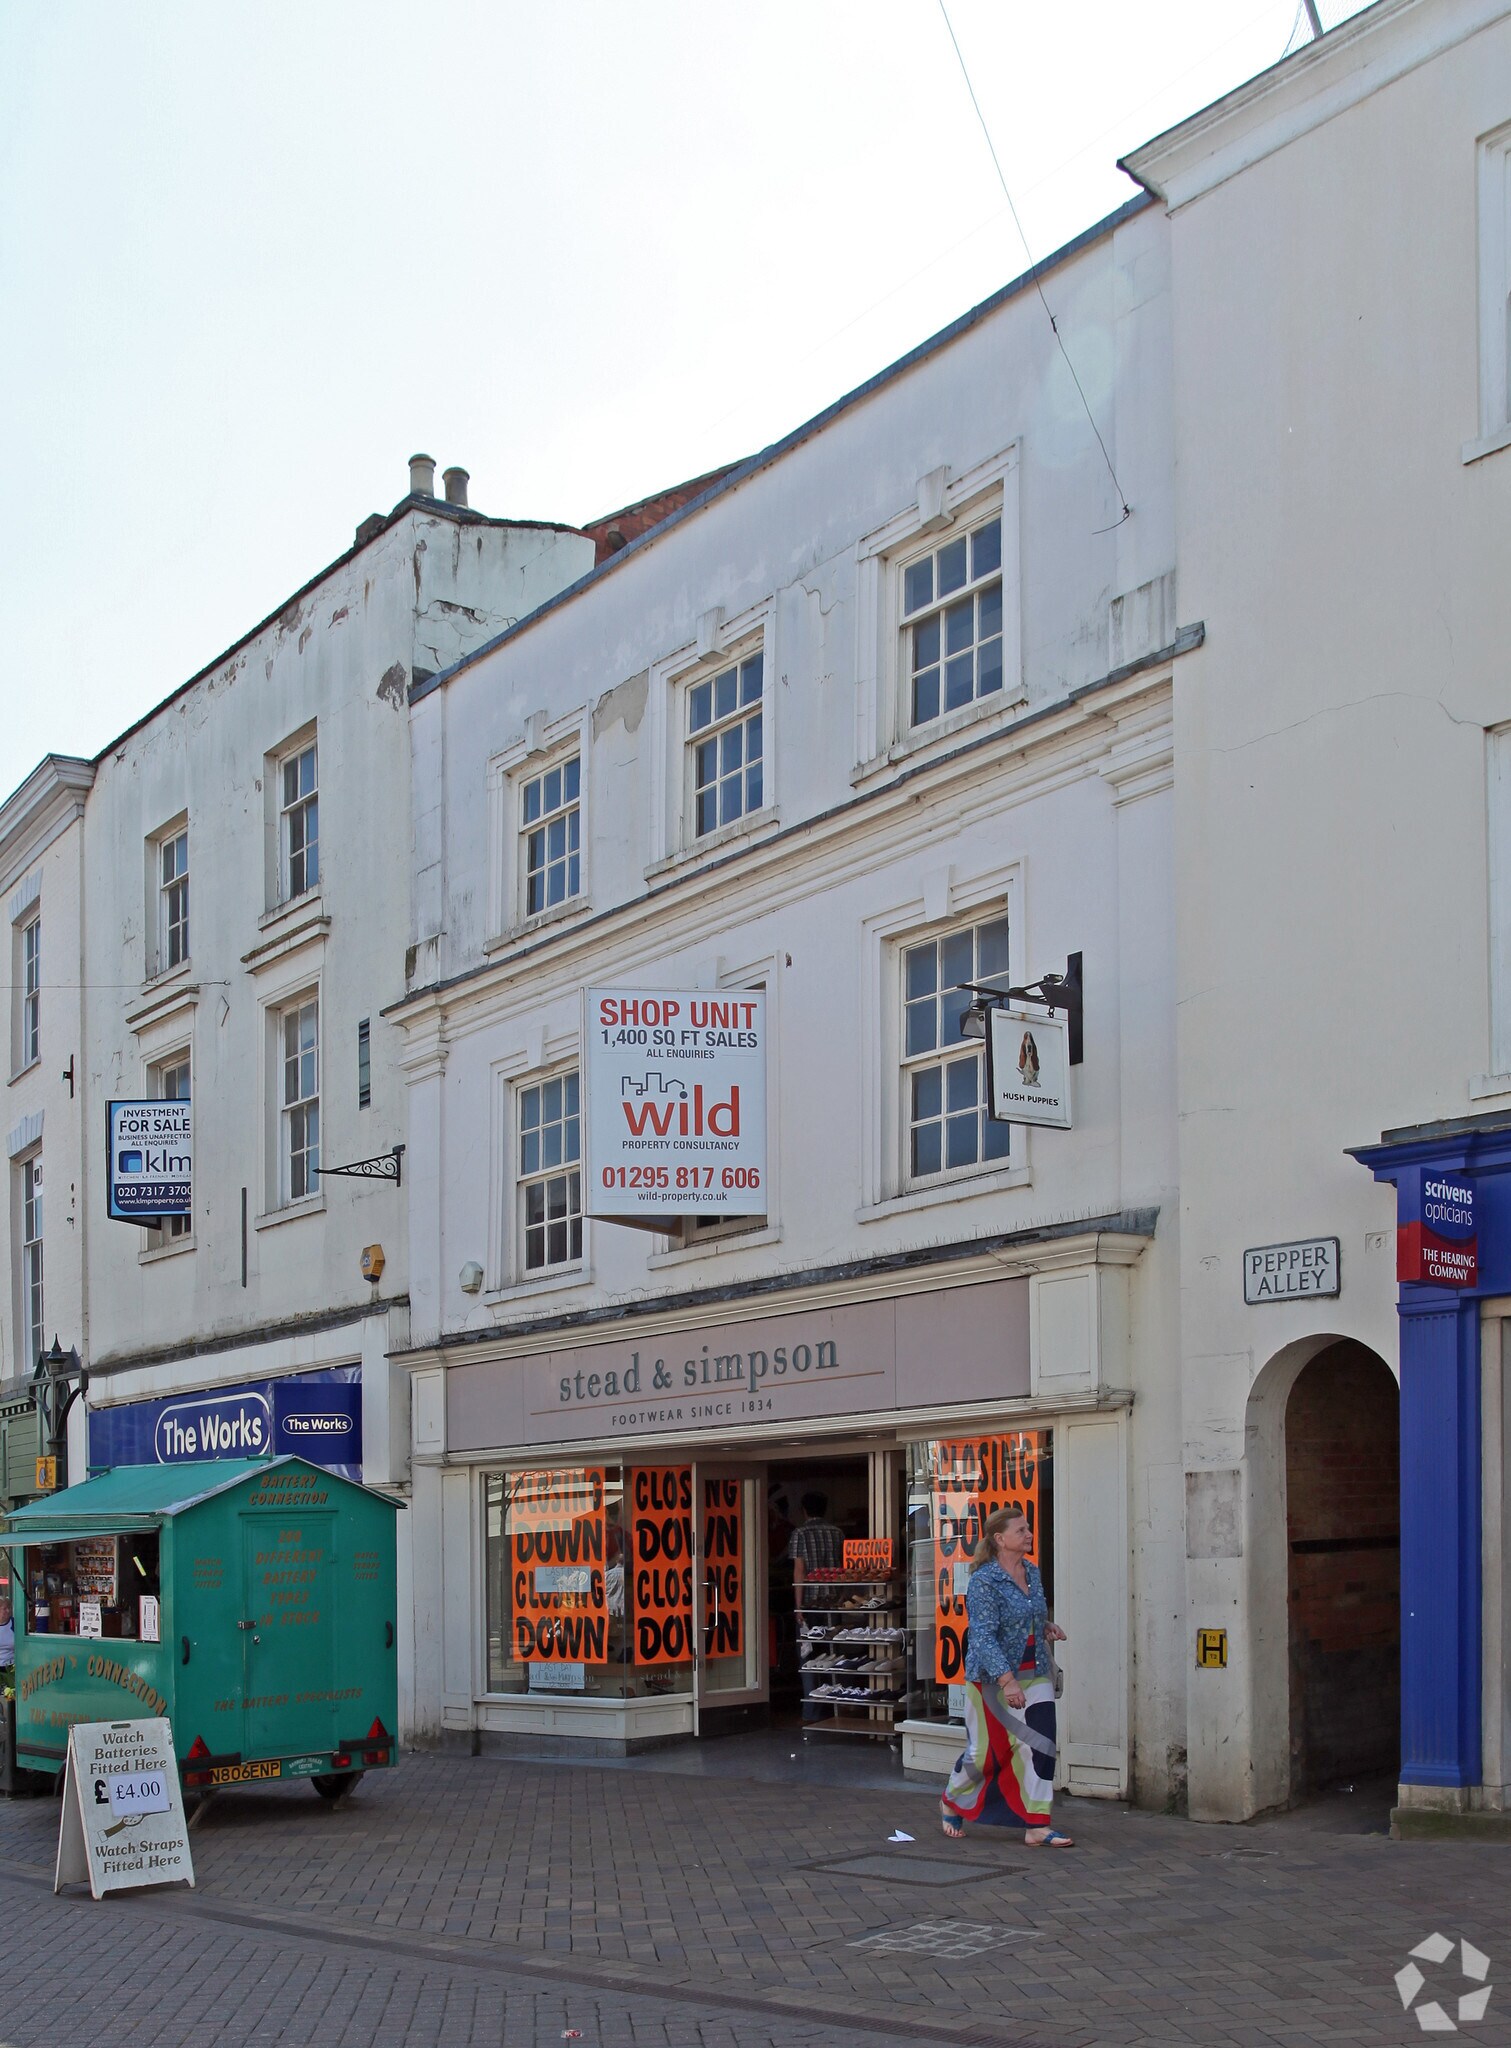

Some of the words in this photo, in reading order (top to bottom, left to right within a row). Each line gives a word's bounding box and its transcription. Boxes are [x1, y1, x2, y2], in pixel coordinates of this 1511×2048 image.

[600, 999, 680, 1027] SHOP
[691, 1002, 758, 1030] UNIT
[601, 1029, 648, 1048] 1,400
[652, 1030, 675, 1047] SQ
[681, 1030, 700, 1046] FT
[706, 1031, 758, 1048] SALES
[646, 1049, 664, 1058] ALL
[666, 1050, 715, 1059] ENQUIRIES
[1003, 1092, 1025, 1102] HUSH
[1028, 1096, 1059, 1106] PUPPIES
[124, 1108, 186, 1118] INVESTMENT
[622, 1084, 740, 1137] wild
[120, 1120, 149, 1132] FOR
[154, 1118, 190, 1132] SALE
[622, 1140, 670, 1149] PROPERTY
[673, 1141, 740, 1151] CONSULTANCY
[146, 1149, 191, 1172] klm
[602, 1166, 669, 1188] 01295
[676, 1166, 714, 1188] 817
[721, 1167, 760, 1189] 606
[118, 1187, 137, 1197] 020
[140, 1186, 165, 1196] 7317
[637, 1192, 728, 1202] wild-property.co.uk
[1425, 1179, 1473, 1204] scrivens
[1425, 1203, 1473, 1226] opticians
[1252, 1246, 1330, 1275] PEPPER
[1422, 1248, 1438, 1262] THE
[1441, 1251, 1475, 1268] HEARING
[1257, 1268, 1326, 1296] ALLEY
[1429, 1265, 1468, 1281] COMPANY
[560, 1352, 642, 1402] stead
[652, 1358, 672, 1390] &
[684, 1339, 840, 1394] simpson
[612, 1409, 683, 1426] FOOTWEAR
[691, 1403, 732, 1418] SINCE
[742, 1399, 773, 1413] 1834
[164, 1418, 196, 1456] The
[200, 1408, 262, 1451] Works
[288, 1419, 310, 1430] The
[311, 1418, 348, 1430] Works
[939, 1438, 1035, 1492] CLOSING
[261, 1475, 318, 1489] BATTERY
[636, 1470, 737, 1511] CLOSNG
[248, 1492, 328, 1505] CONNECTION
[514, 1471, 602, 1515] CLOSING
[514, 1518, 602, 1564] DOWN
[846, 1541, 889, 1556] CLOSING
[255, 1550, 323, 1565] DIFFERENT
[846, 1557, 889, 1569] DOWN
[263, 1569, 317, 1585] BATTERY
[637, 1565, 738, 1609] CLOSNG
[270, 1591, 309, 1606] TYPES
[260, 1613, 273, 1628] IN
[280, 1611, 320, 1625] STOCK
[516, 1616, 605, 1659] DOWN
[1203, 1634, 1223, 1664] H
[20, 1655, 66, 1701] BATTERY
[88, 1655, 167, 1716] CONNECTION
[213, 1700, 235, 1712] THE
[241, 1694, 290, 1709] BATTERY
[296, 1688, 363, 1702] SPECIALISTS
[102, 1731, 144, 1745] Watch
[95, 1745, 158, 1760] Batteries
[90, 1760, 130, 1775] Fitted
[134, 1758, 167, 1770] Here
[210, 1762, 280, 1783] N806ENP
[116, 1781, 161, 1800] £4.00
[95, 1842, 136, 1858] Watch
[140, 1838, 184, 1853] Straps
[103, 1858, 144, 1874] Fitted
[148, 1856, 182, 1868] Here
